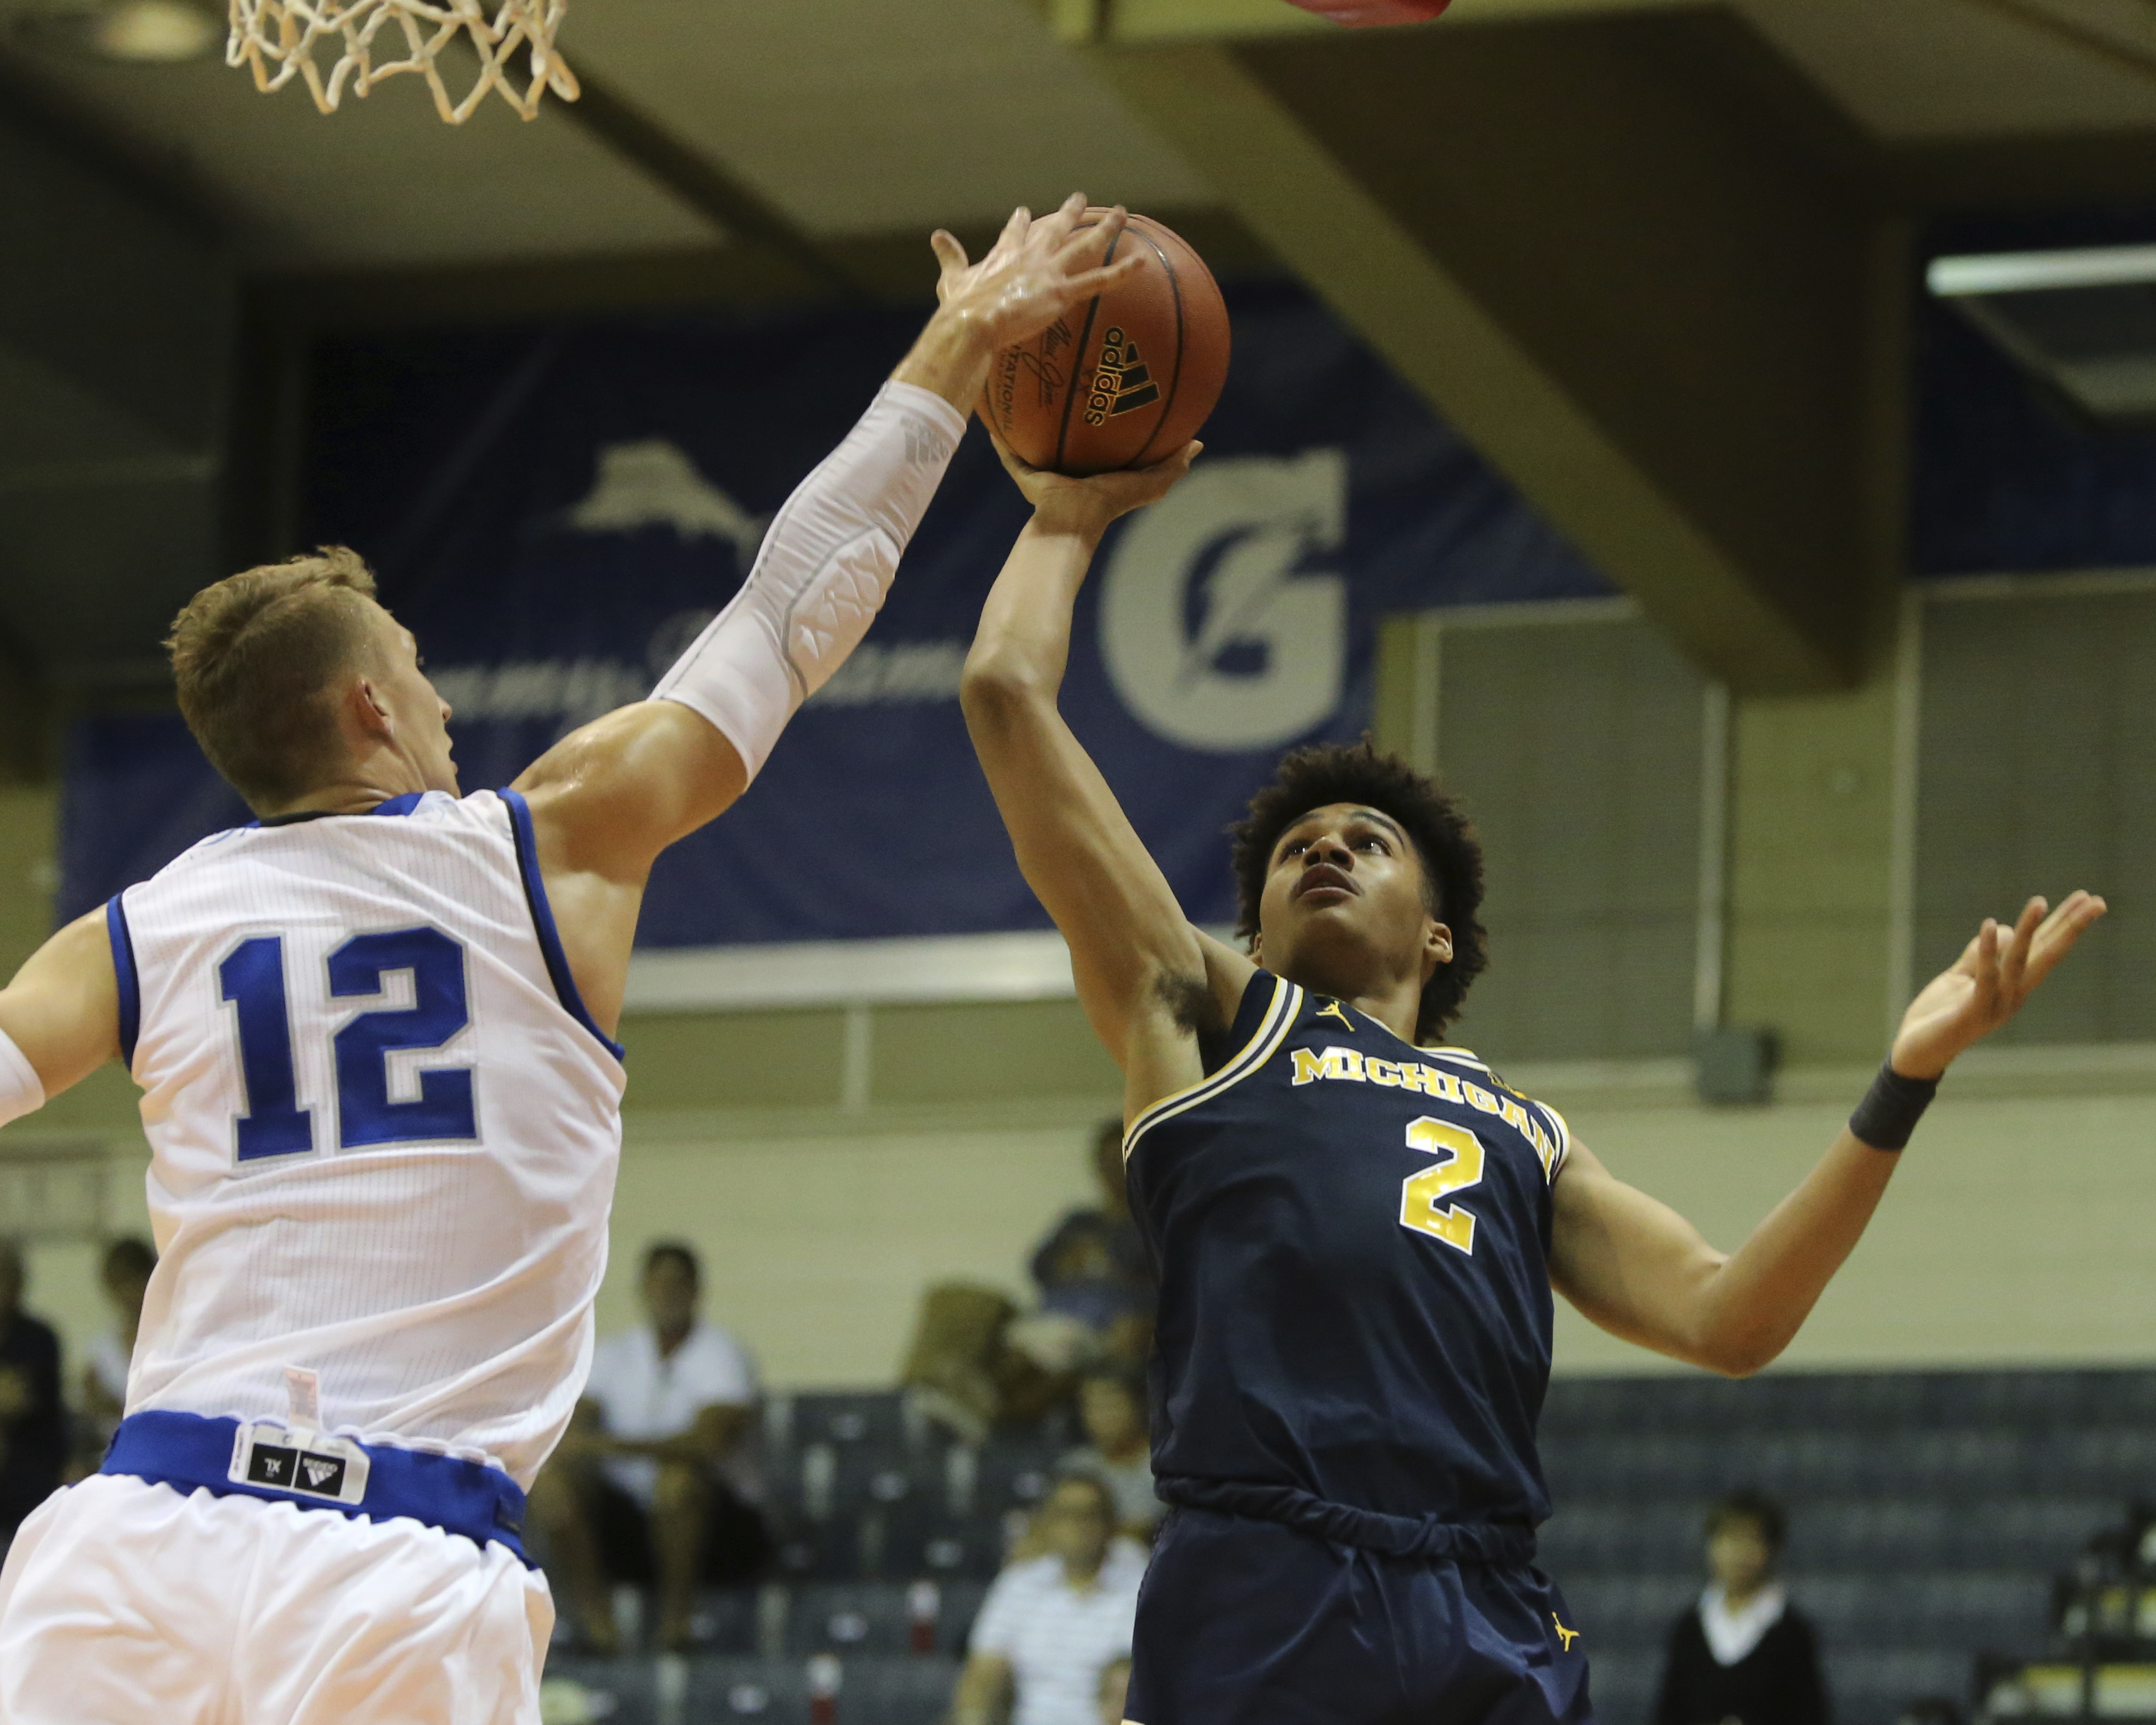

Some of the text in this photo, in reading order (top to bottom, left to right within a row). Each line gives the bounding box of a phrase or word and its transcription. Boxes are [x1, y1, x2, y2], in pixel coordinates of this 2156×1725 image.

[1084, 327, 1124, 426] adidas
[1098, 448, 1347, 752] G
[212, 921, 483, 1169] 12
[1400, 1116, 1485, 1256] 2
